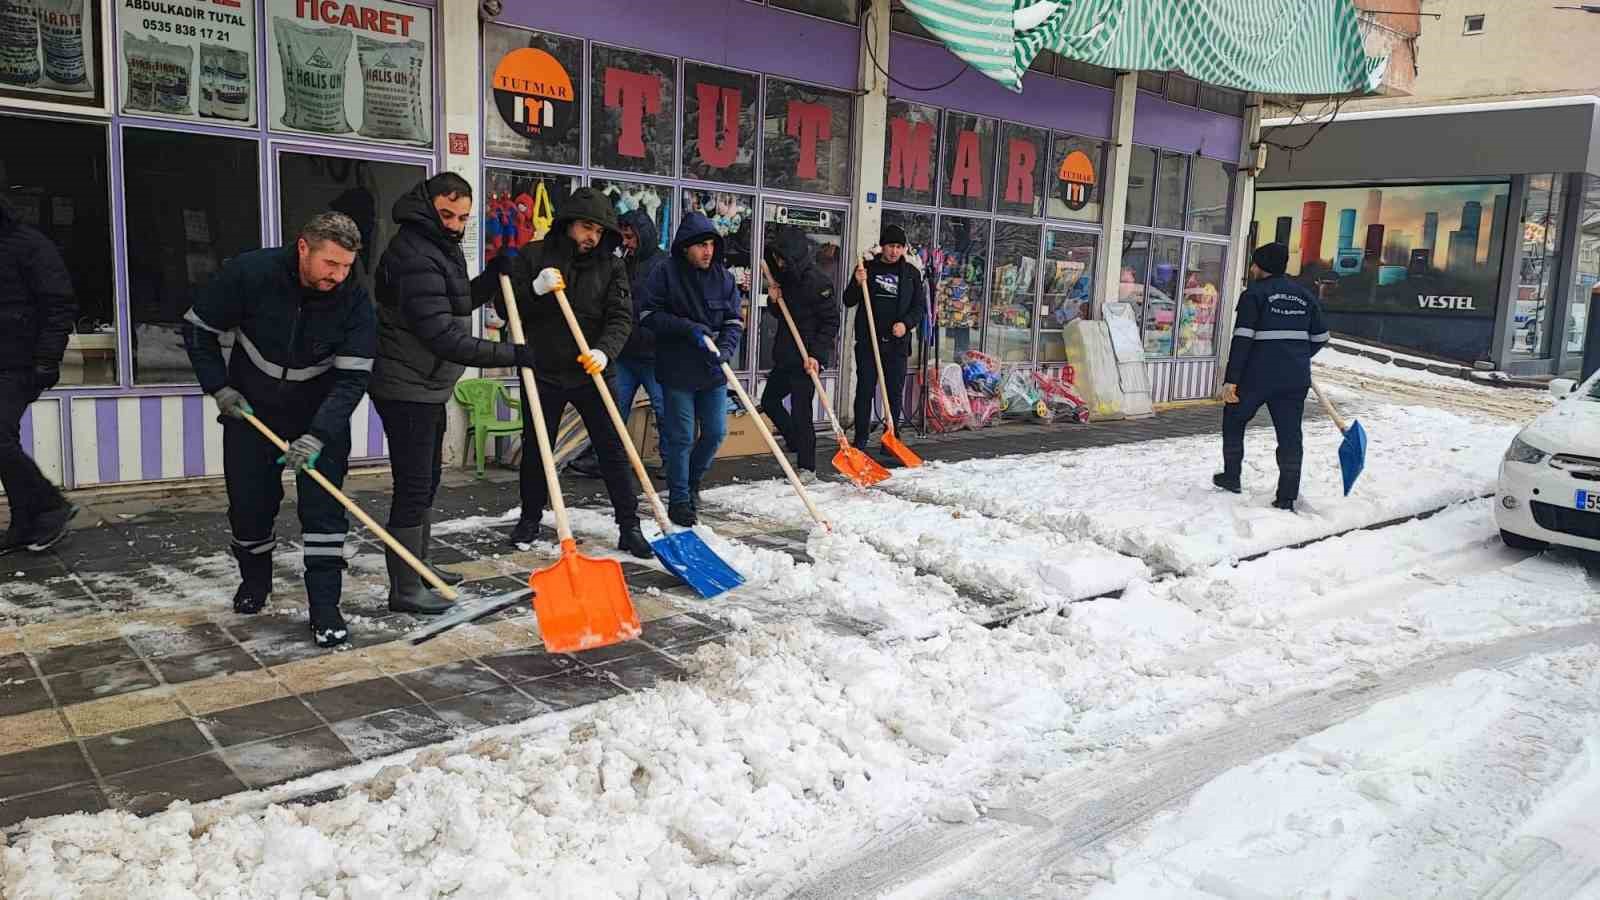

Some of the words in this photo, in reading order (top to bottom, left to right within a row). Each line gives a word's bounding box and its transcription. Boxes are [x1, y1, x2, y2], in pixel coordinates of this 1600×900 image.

[125, 0, 205, 20] ABDULKADİR
[207, 11, 246, 26] TUTAL
[142, 19, 172, 33] 0535
[175, 24, 196, 37] 838
[200, 28, 213, 39] 17
[217, 31, 230, 42] 21
[500, 76, 566, 98] TUTMAR
[1417, 295, 1476, 310] VESTEL
